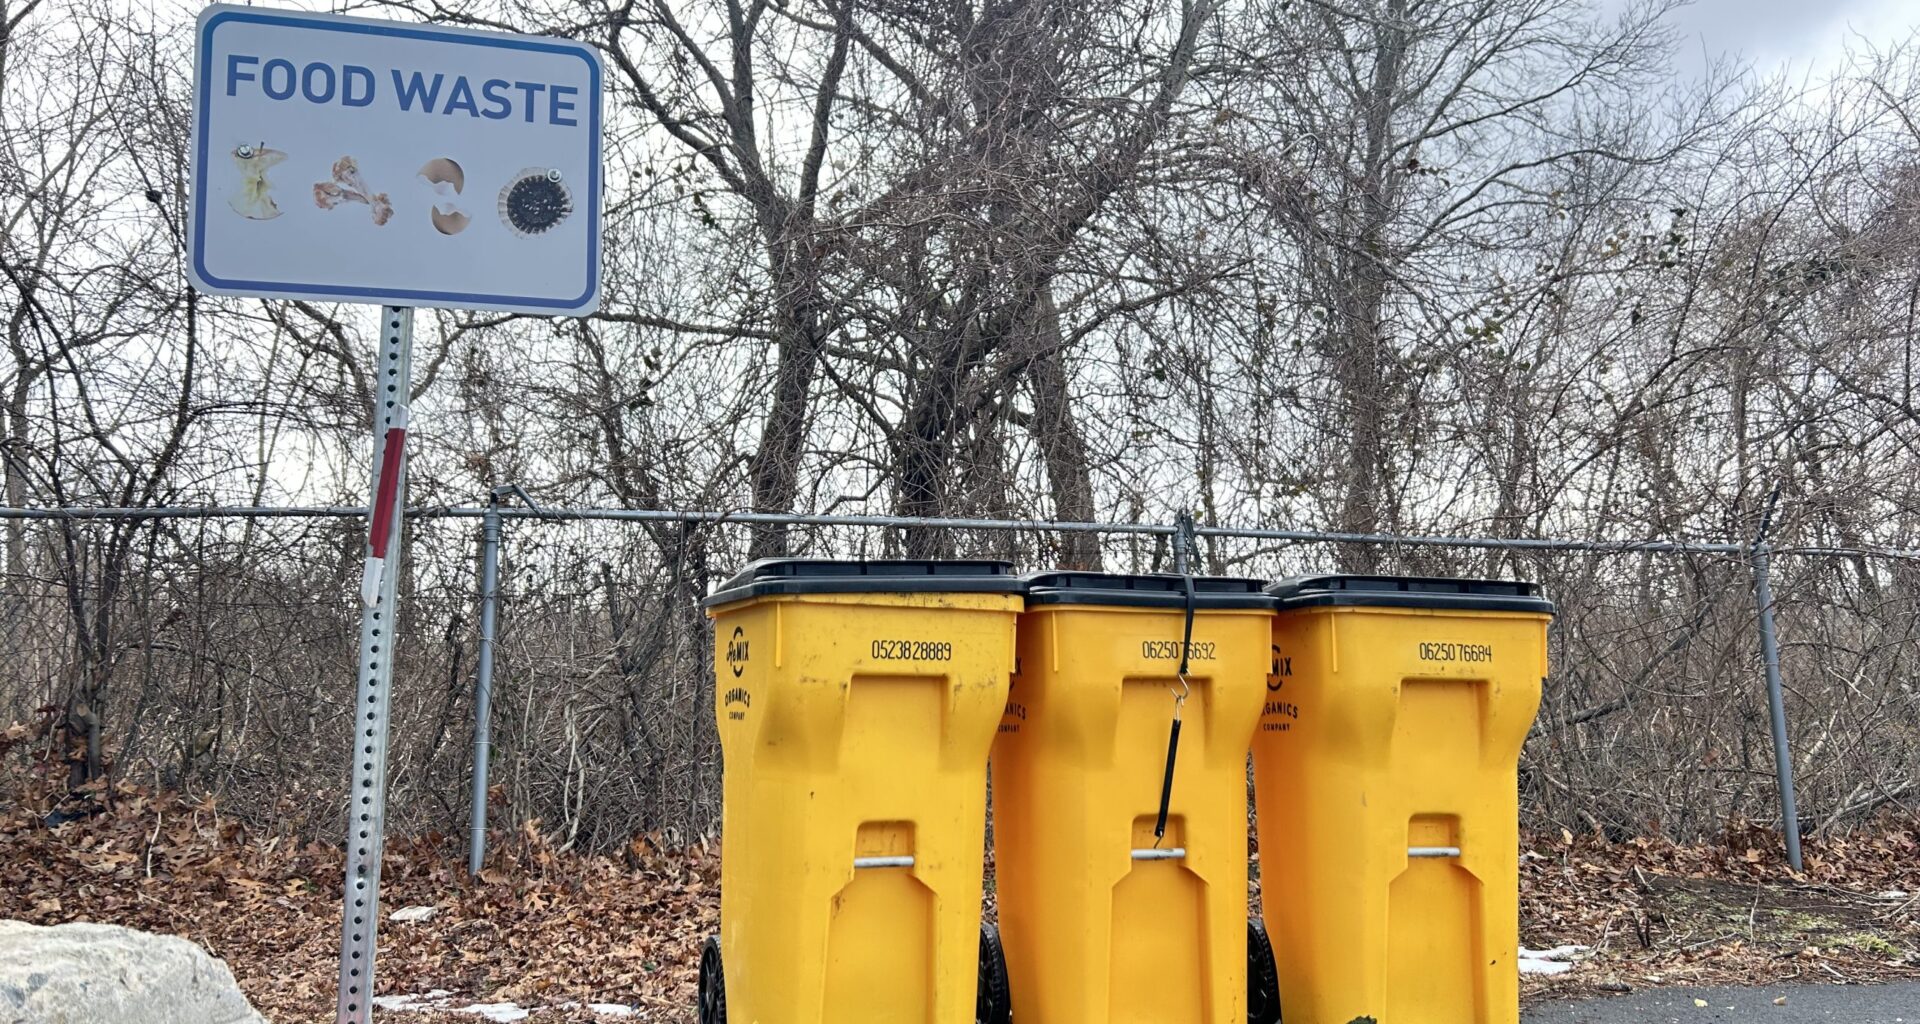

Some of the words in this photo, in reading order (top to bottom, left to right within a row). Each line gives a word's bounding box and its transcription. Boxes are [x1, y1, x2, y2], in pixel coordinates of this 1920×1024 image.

[226, 54, 376, 107] FOOD
[390, 69, 578, 127] WASTE
[871, 639, 952, 661] 0523828889
[1419, 642, 1492, 662] 0625076684
[1272, 657, 1292, 676] MIX
[725, 687, 750, 708] ORGANICS
[728, 711, 745, 721] COMPANY
[1004, 703, 1026, 721] ANICS
[1262, 701, 1298, 719] GANICS
[1263, 723, 1290, 732] COMPANY
